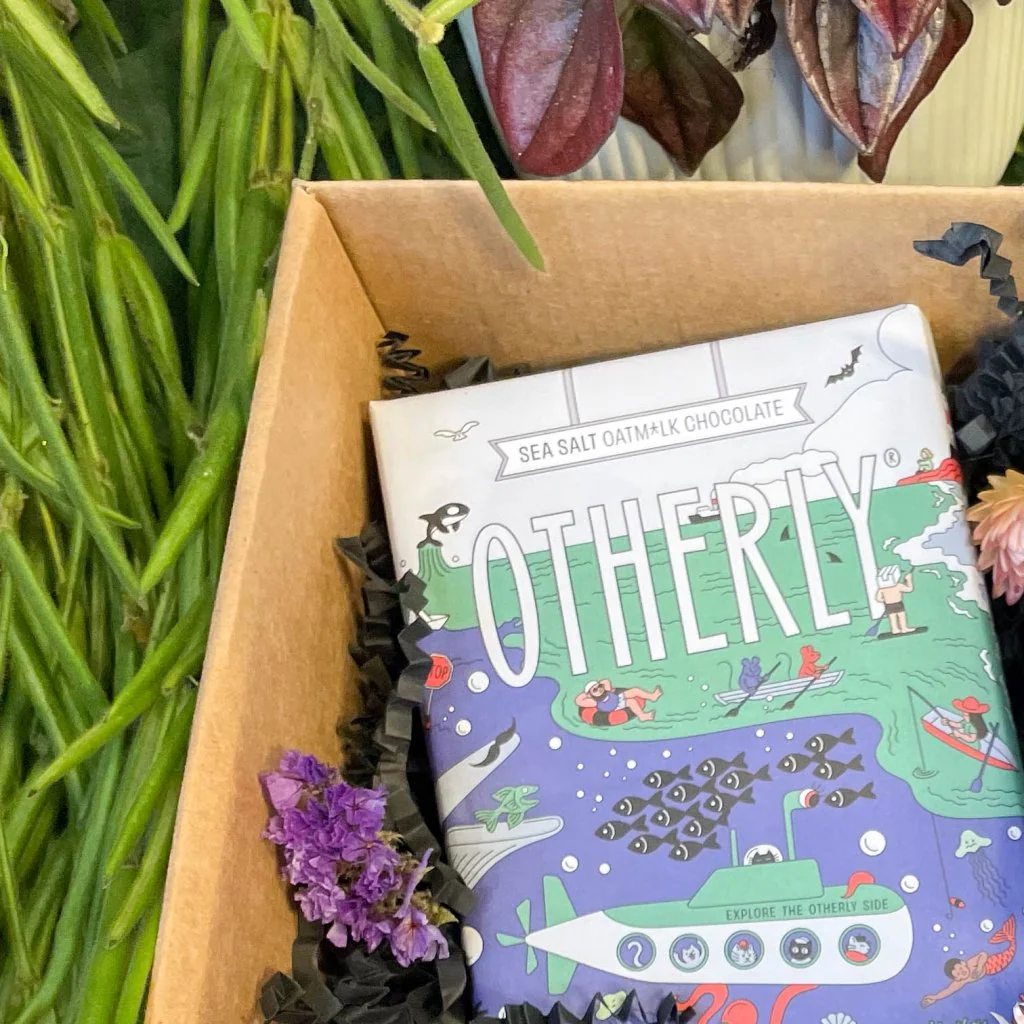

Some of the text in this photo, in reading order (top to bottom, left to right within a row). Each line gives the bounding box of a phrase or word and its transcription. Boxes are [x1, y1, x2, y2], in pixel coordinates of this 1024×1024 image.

[518, 441, 555, 464] SEA
[558, 432, 598, 456] SALT
[684, 399, 785, 431] CHOCOLATE
[725, 898, 889, 921] EXPLORE THE OTHERLY SIDE
